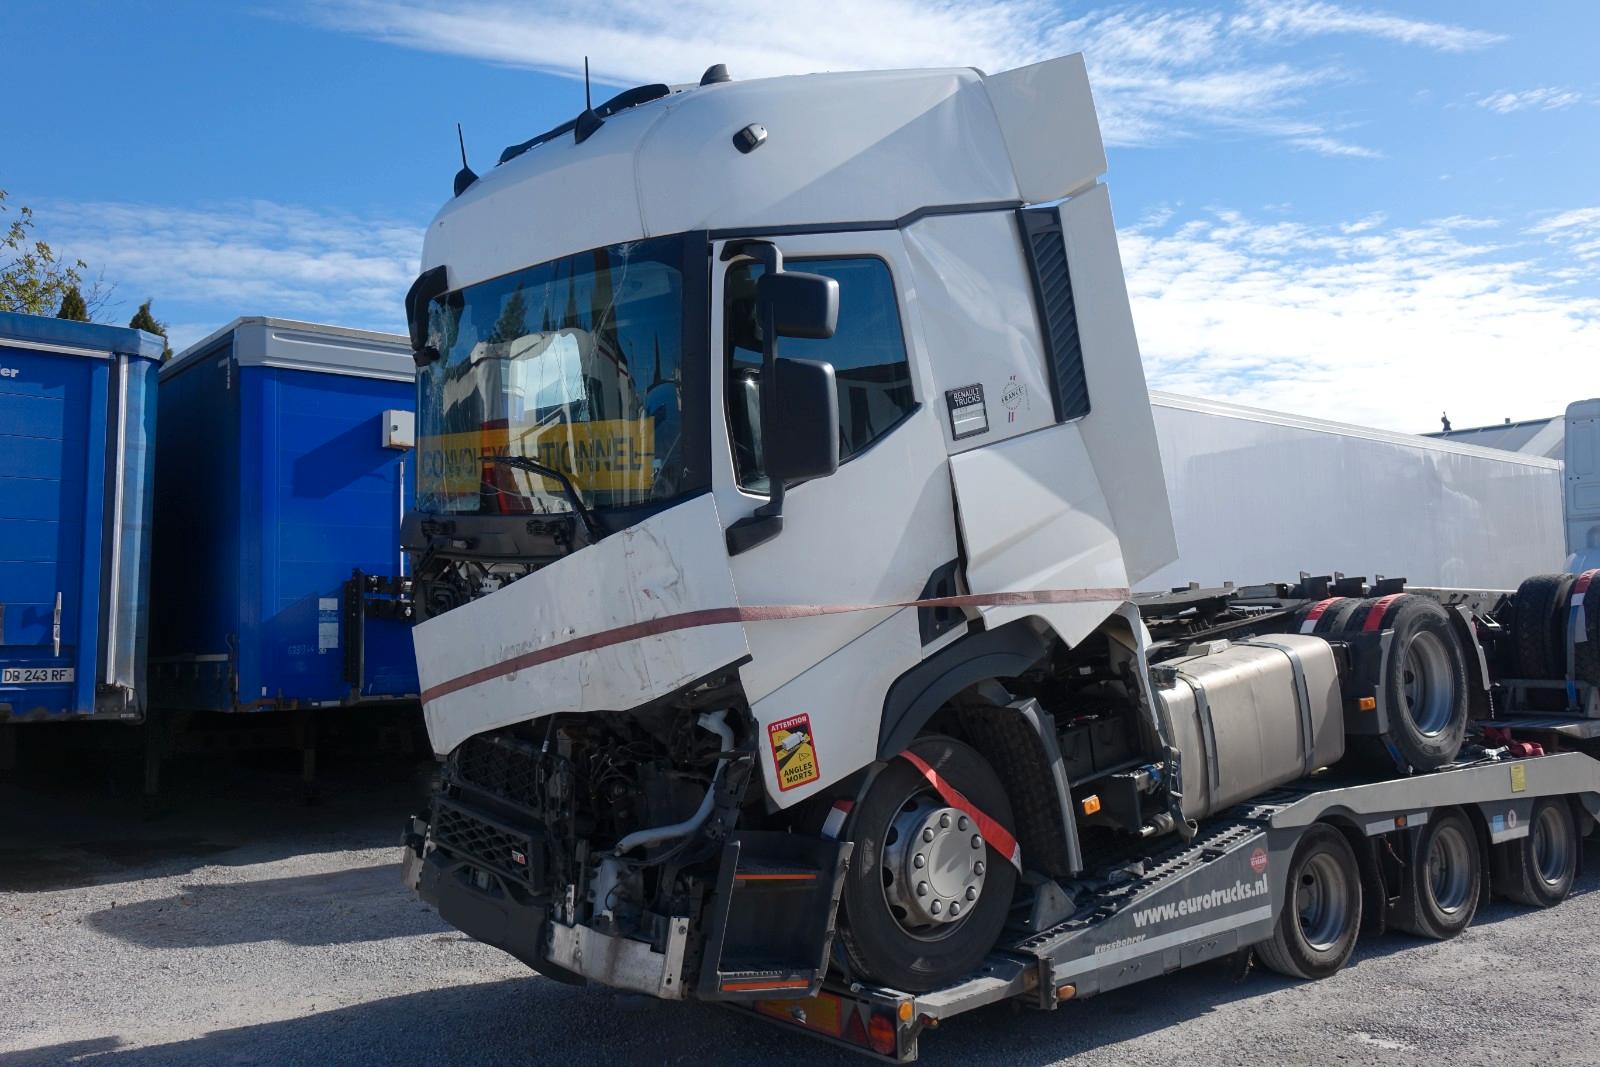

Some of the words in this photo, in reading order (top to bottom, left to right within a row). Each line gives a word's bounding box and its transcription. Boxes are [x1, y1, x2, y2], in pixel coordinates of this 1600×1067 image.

[953, 387, 979, 400] RENAULT
[955, 394, 980, 407] TRUCKS
[1001, 387, 1024, 404] FRANCE
[4, 670, 20, 682] DB
[24, 669, 48, 682] 243
[51, 669, 68, 681] RF
[770, 715, 807, 732] ATTENTION
[783, 761, 813, 778] ANGLES
[786, 770, 813, 784] MORTS
[1132, 873, 1269, 928] www.eurotrucks.nl
